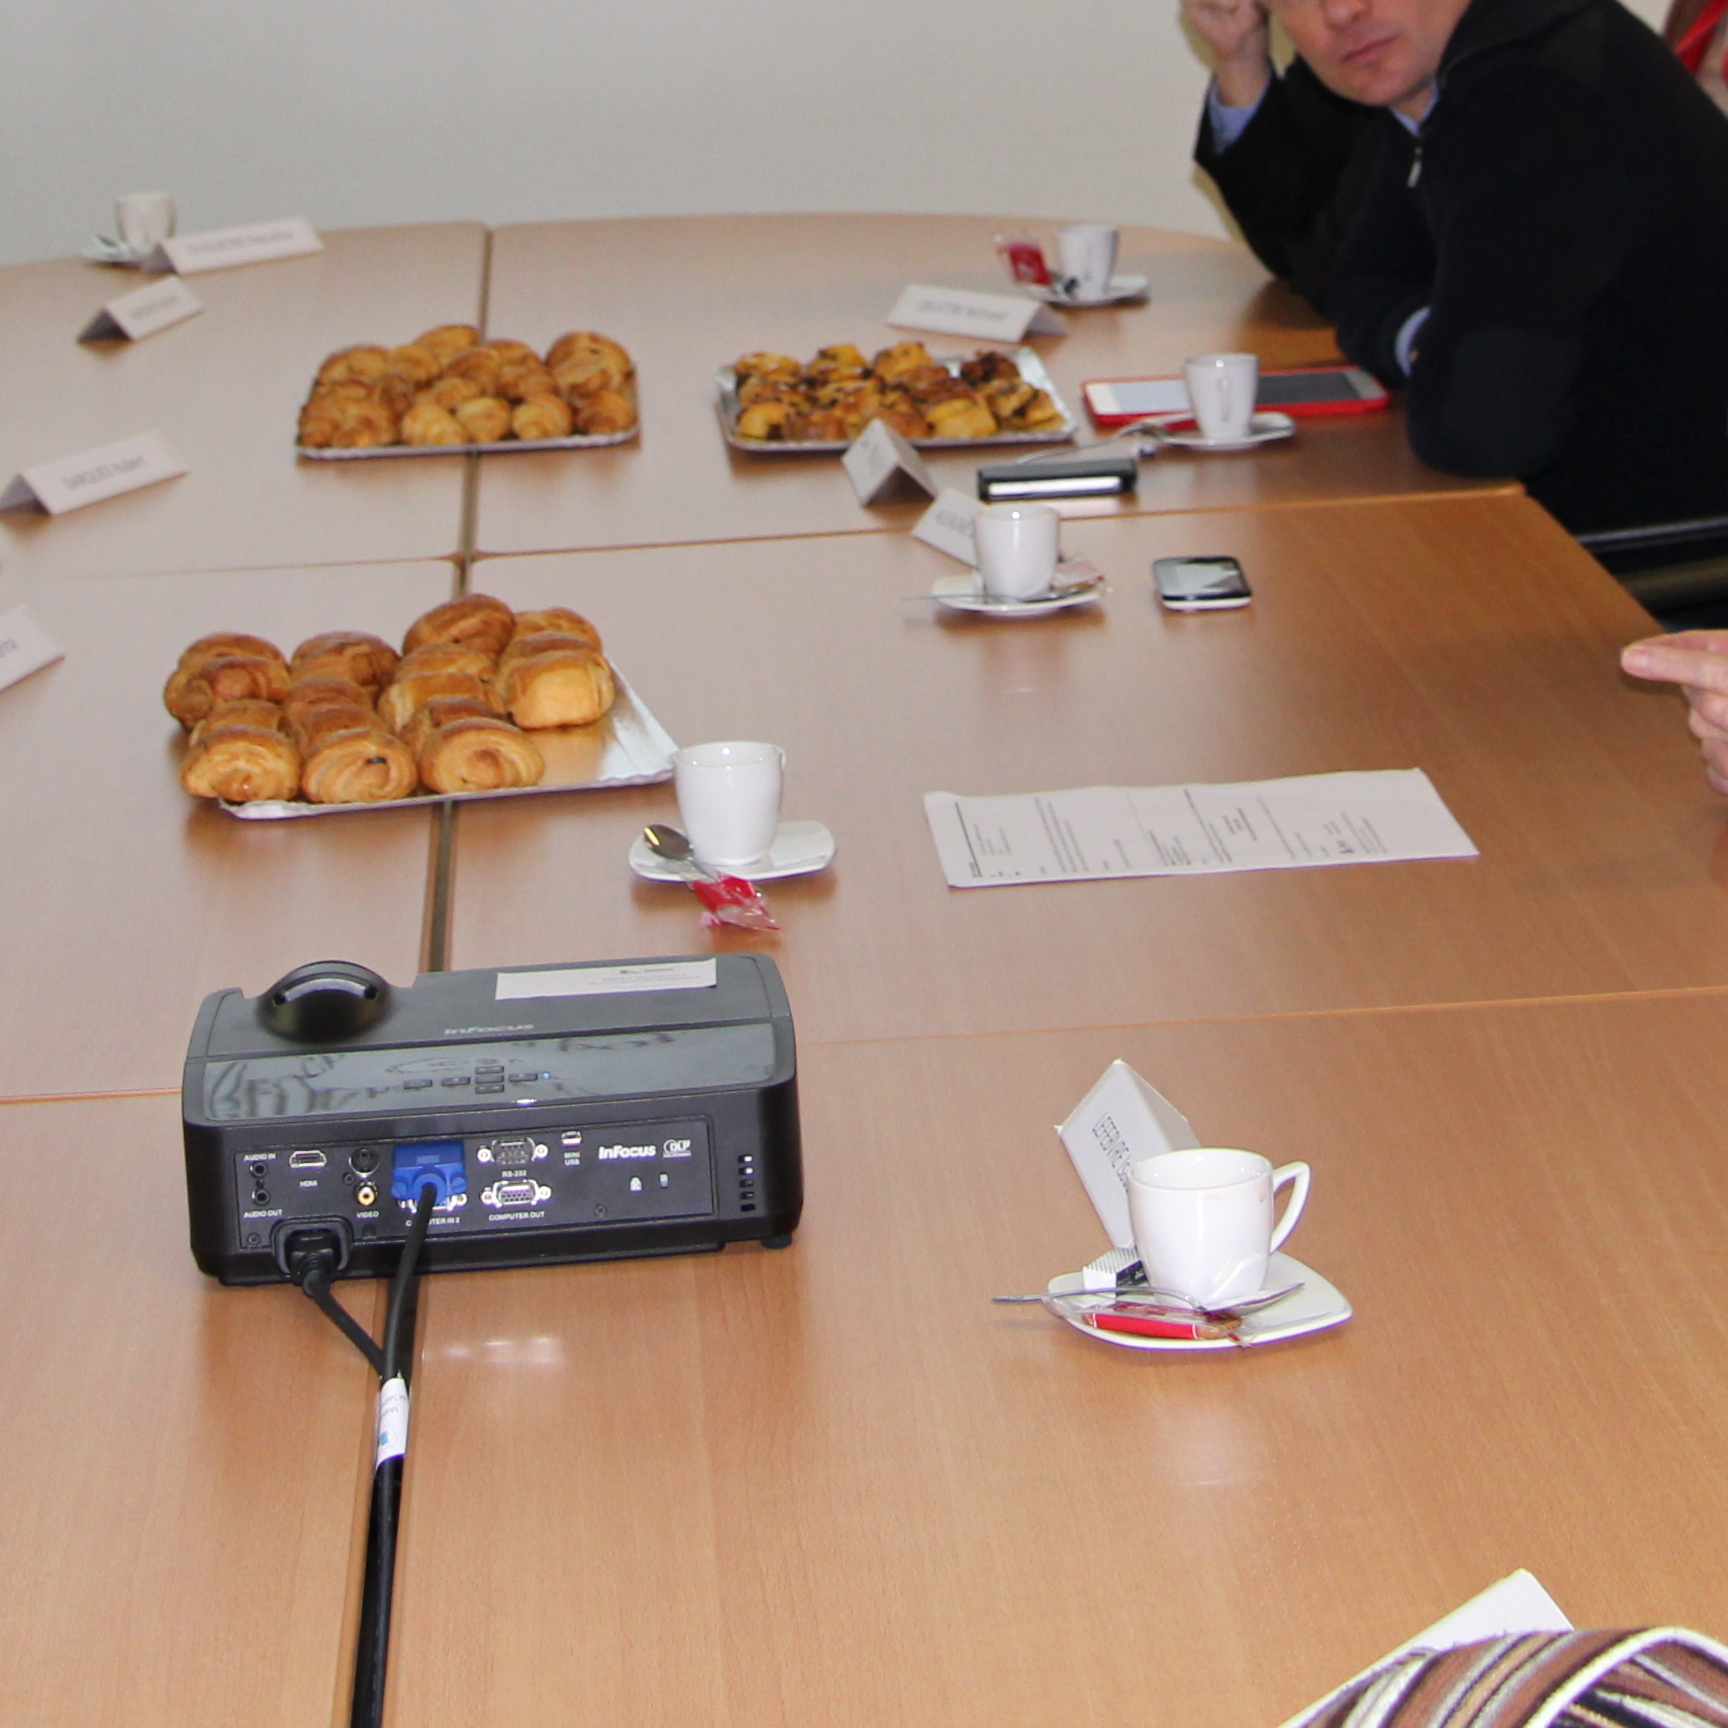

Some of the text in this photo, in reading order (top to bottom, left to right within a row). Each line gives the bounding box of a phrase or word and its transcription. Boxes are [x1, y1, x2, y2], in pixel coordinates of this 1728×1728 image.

[597, 1144, 657, 1160] InFocus
[243, 1209, 283, 1218] AUDIO OUT
[356, 1210, 380, 1219] VIDEO
[488, 1210, 545, 1222] COMPUTER OUT
